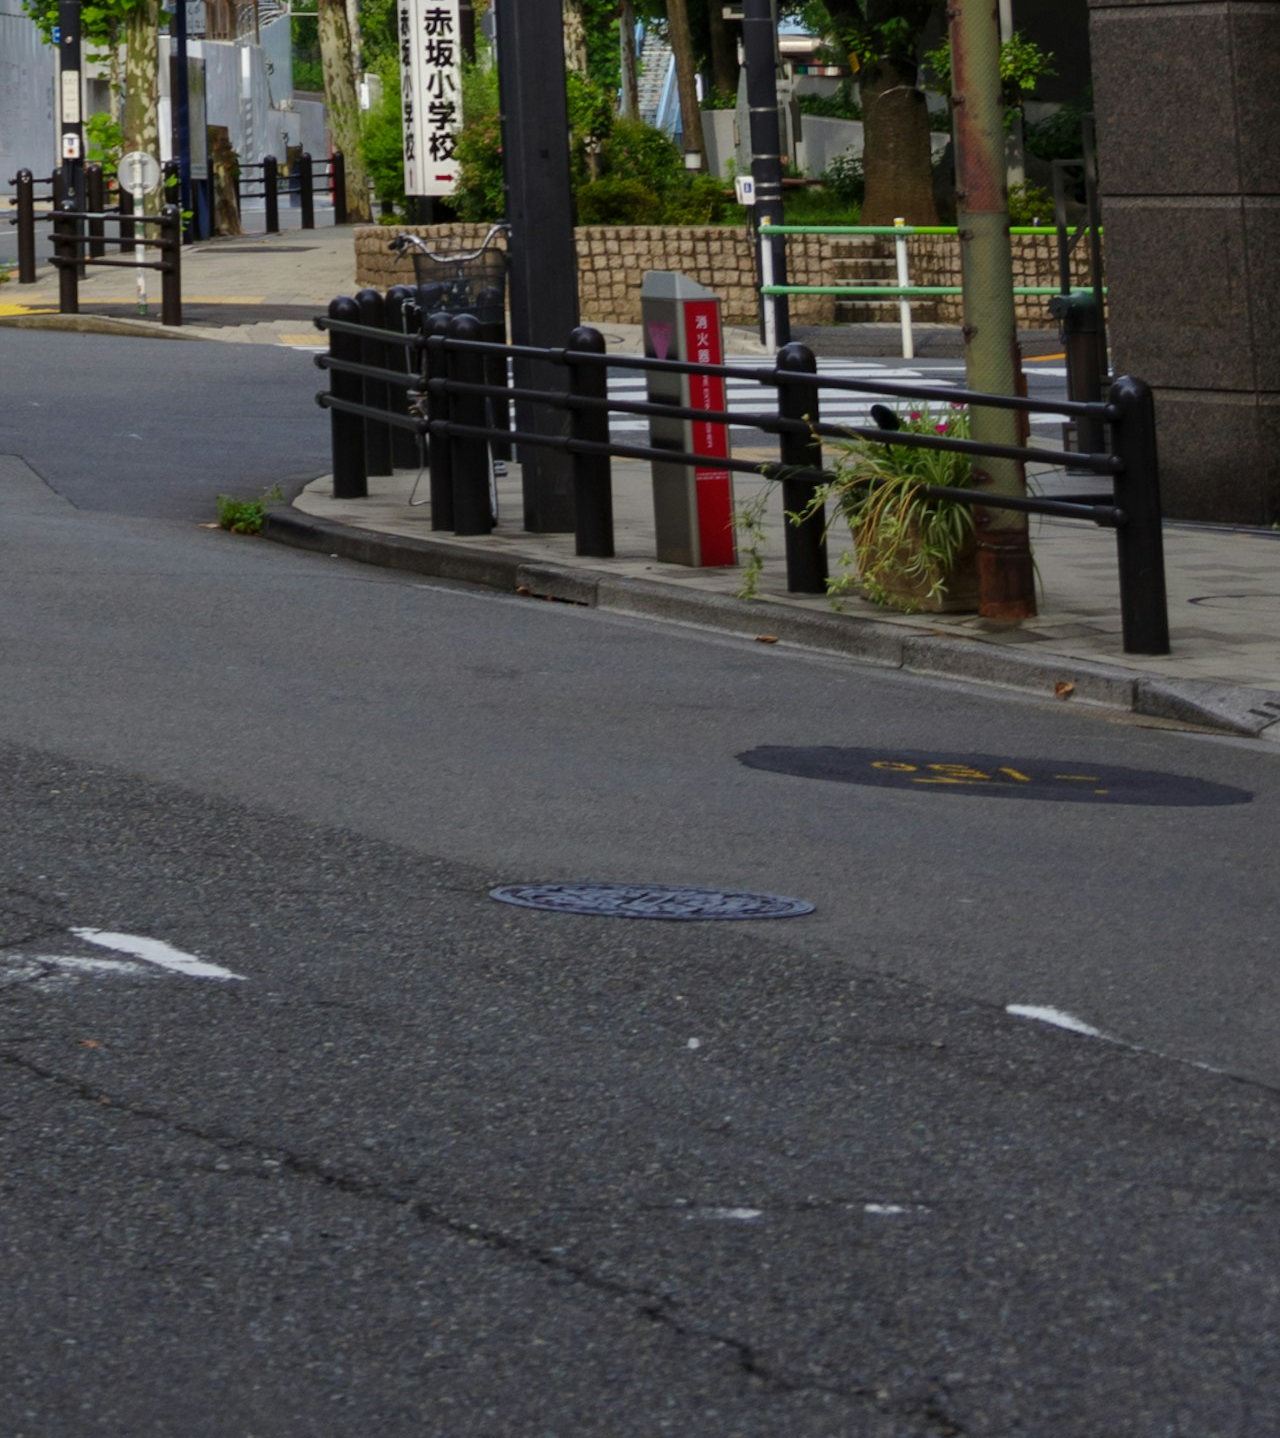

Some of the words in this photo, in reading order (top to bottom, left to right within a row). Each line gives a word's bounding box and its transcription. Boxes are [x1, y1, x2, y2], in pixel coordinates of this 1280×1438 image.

[424, 7, 458, 163] 赤坂小学校
[695, 314, 710, 363] 消火器
